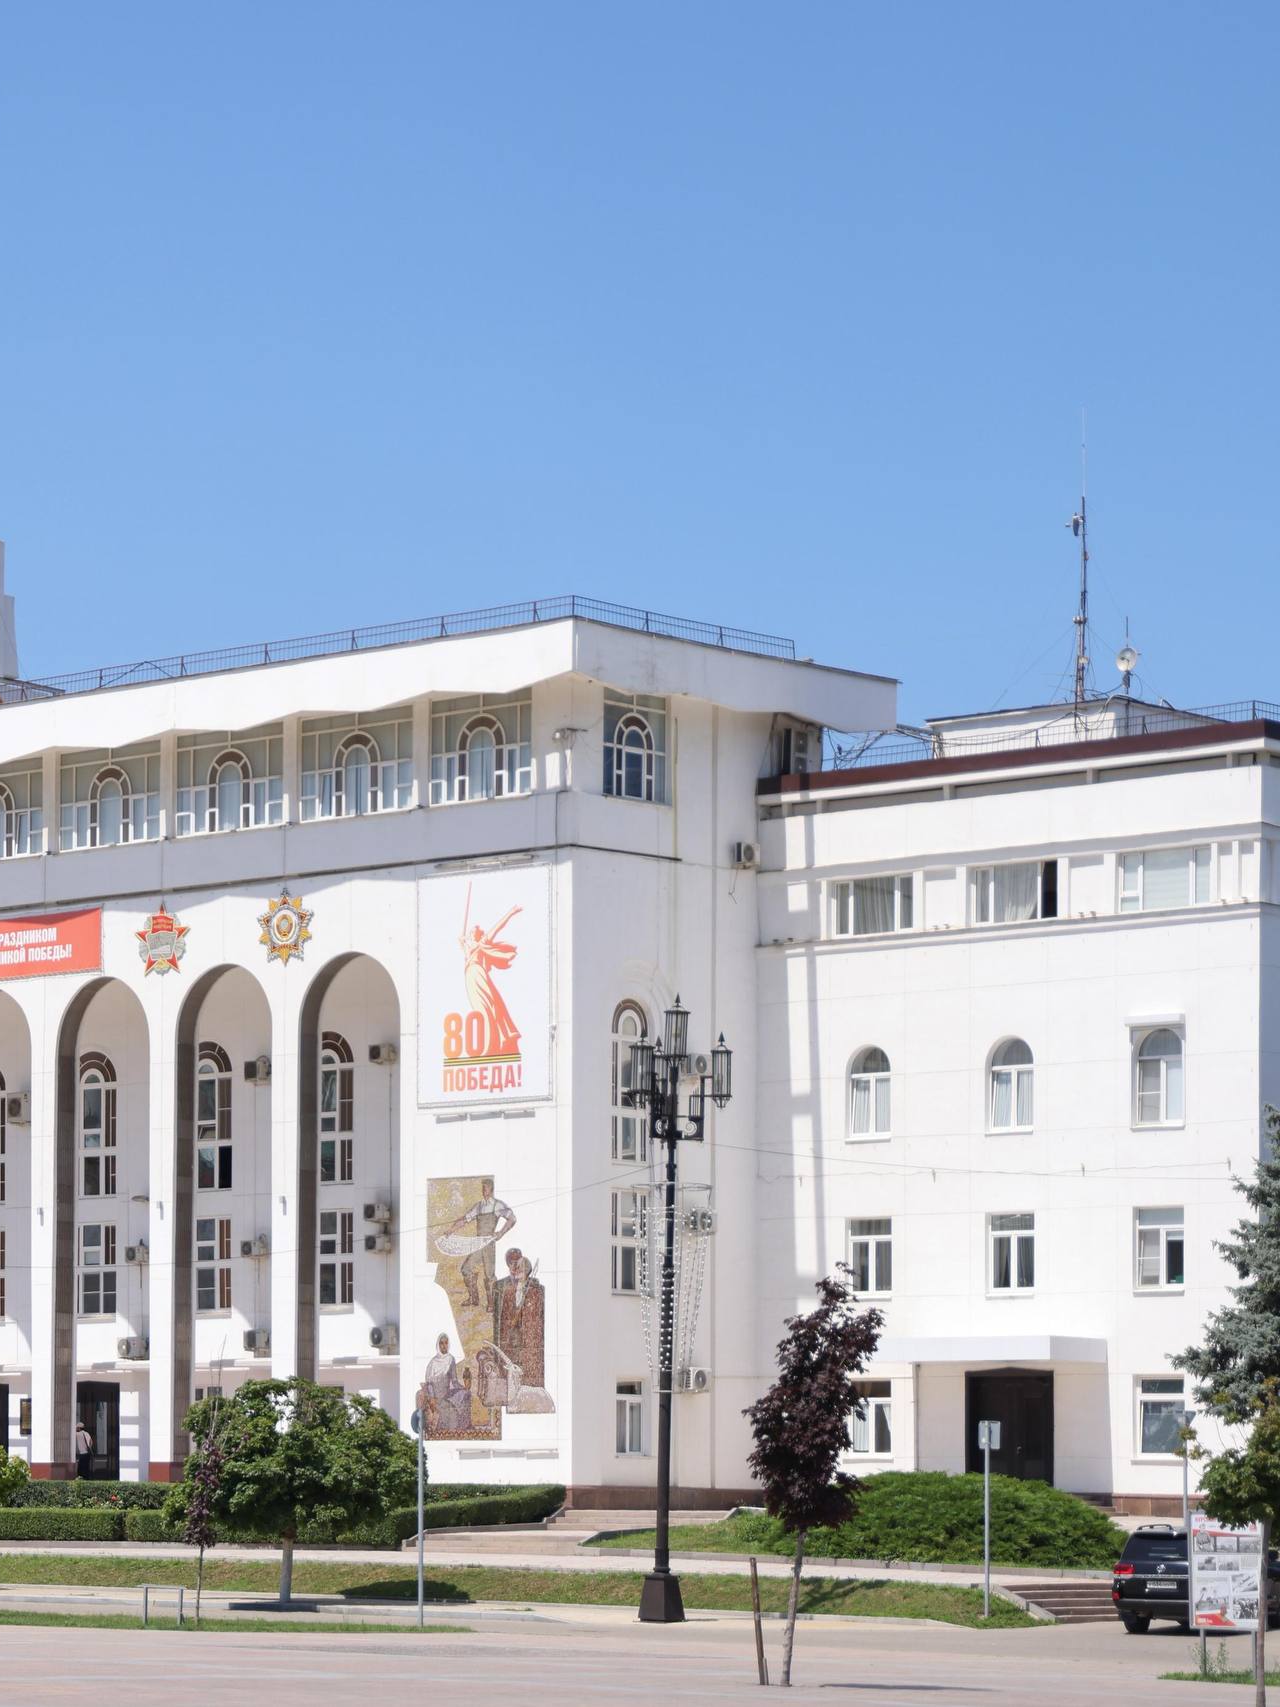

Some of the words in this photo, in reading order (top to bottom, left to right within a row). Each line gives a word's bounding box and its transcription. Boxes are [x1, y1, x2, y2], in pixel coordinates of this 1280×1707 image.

[28, 944, 72, 962] ПОБЕДЫ!
[443, 1011, 485, 1059] 80
[443, 1064, 522, 1092] ПОБЕДА!
